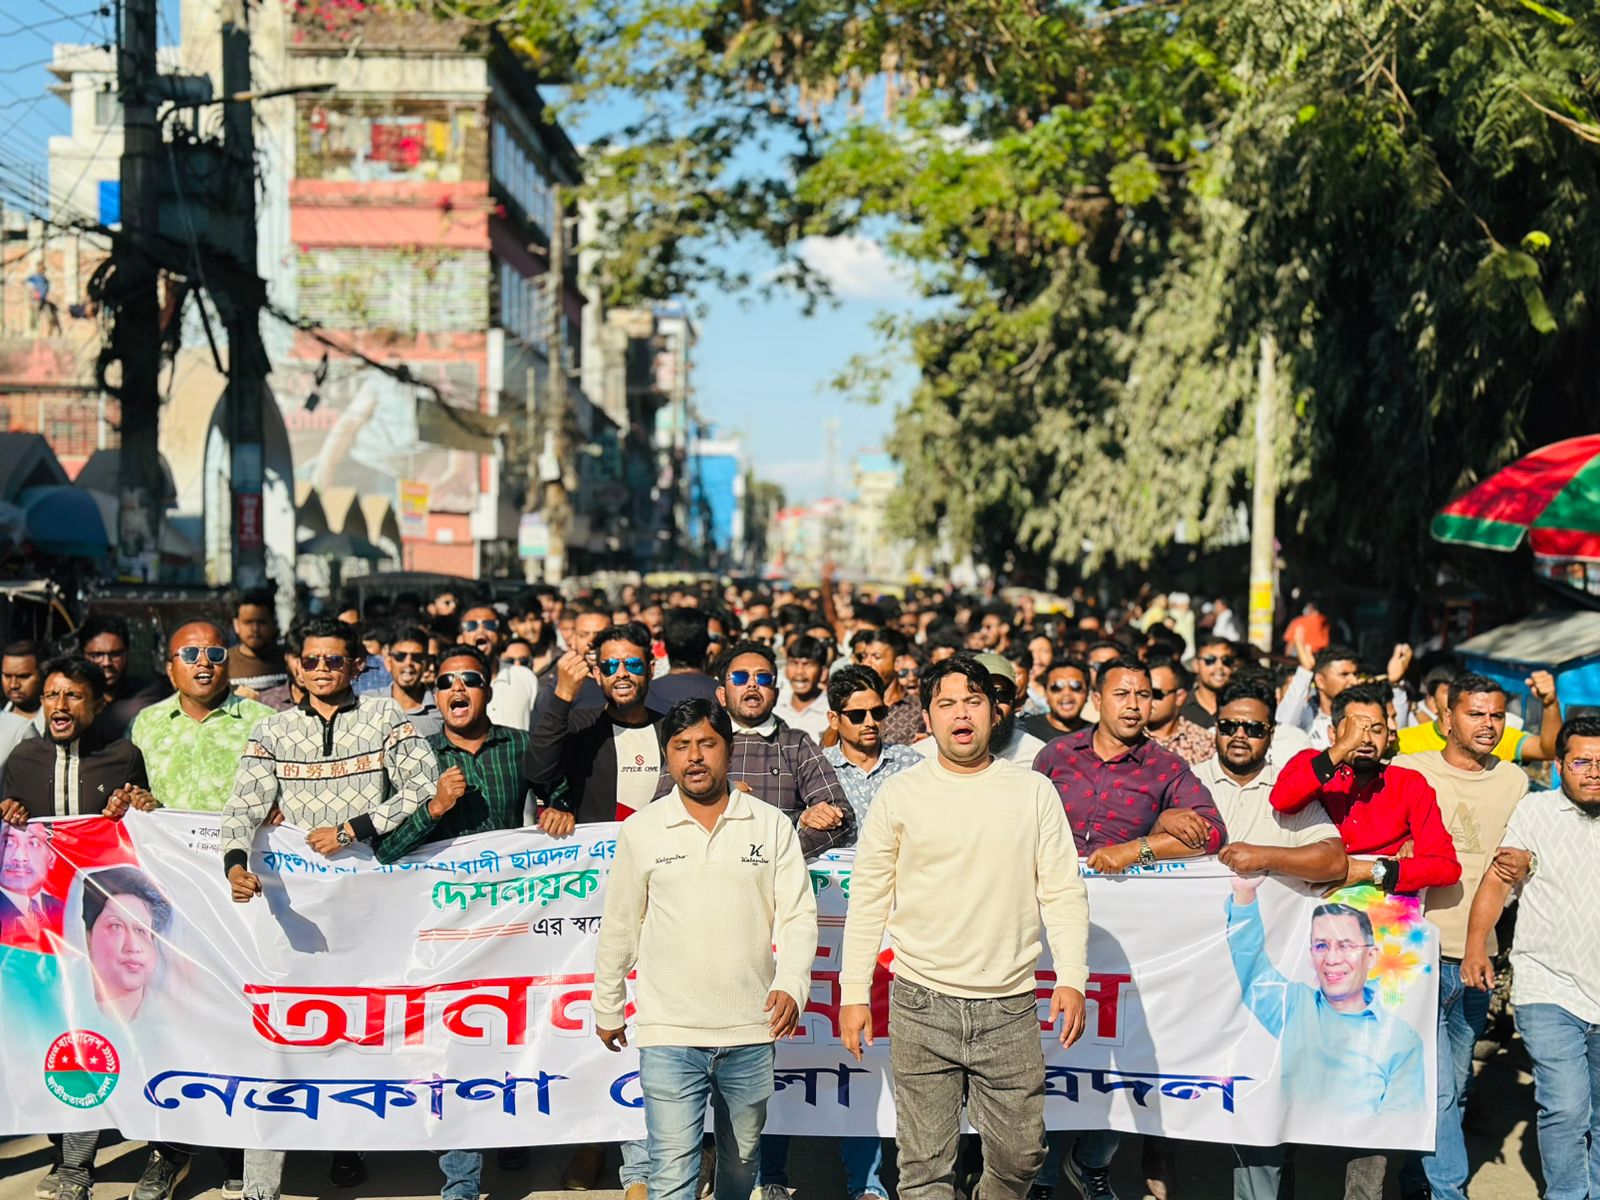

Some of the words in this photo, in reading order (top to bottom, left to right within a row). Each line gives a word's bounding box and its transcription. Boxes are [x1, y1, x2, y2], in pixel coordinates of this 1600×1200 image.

[199, 827, 220, 837] বাংলা
[508, 844, 582, 871] ছাত্রদল
[431, 868, 600, 911] দেশনায়ক
[533, 917, 565, 936] এর
